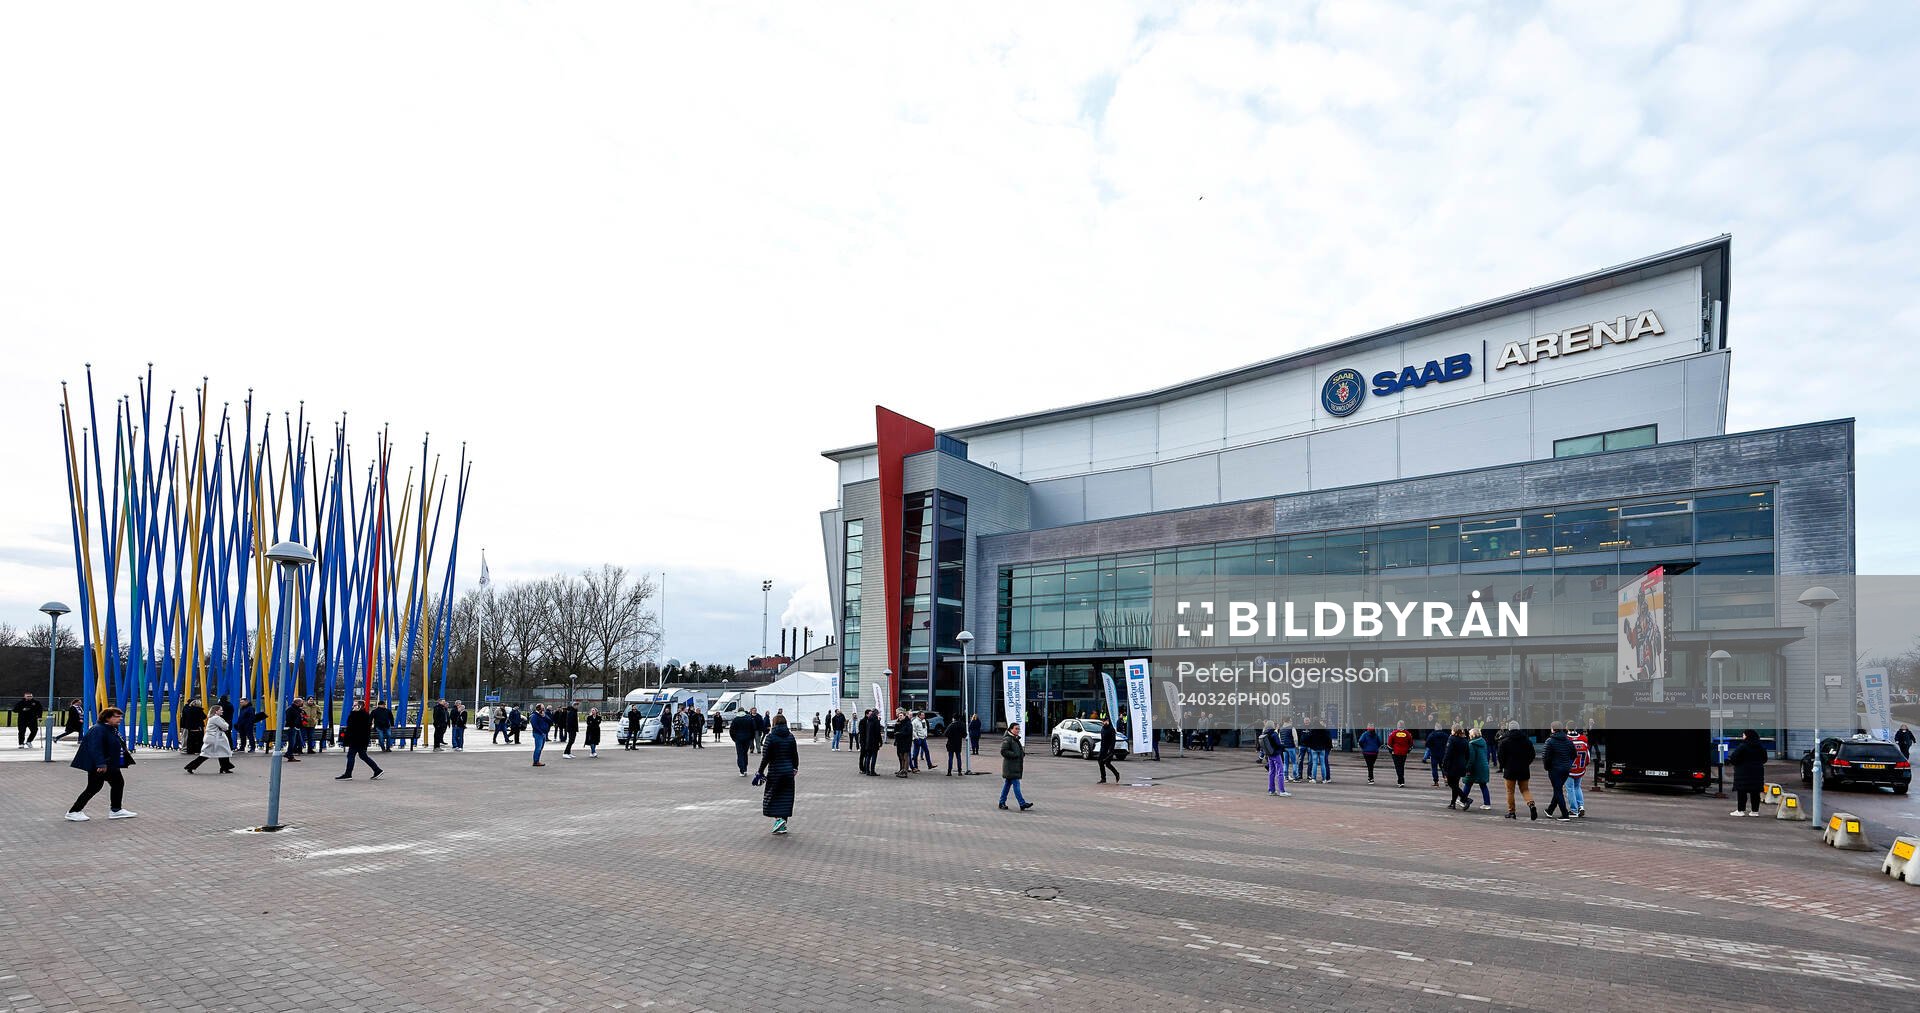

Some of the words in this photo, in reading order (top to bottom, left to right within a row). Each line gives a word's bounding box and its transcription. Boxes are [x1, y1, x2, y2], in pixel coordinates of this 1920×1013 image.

[1371, 353, 1473, 396] SAAB
[1496, 309, 1666, 370] ARENA
[1332, 372, 1354, 385] SAAB
[1294, 657, 1327, 665] ARENA
